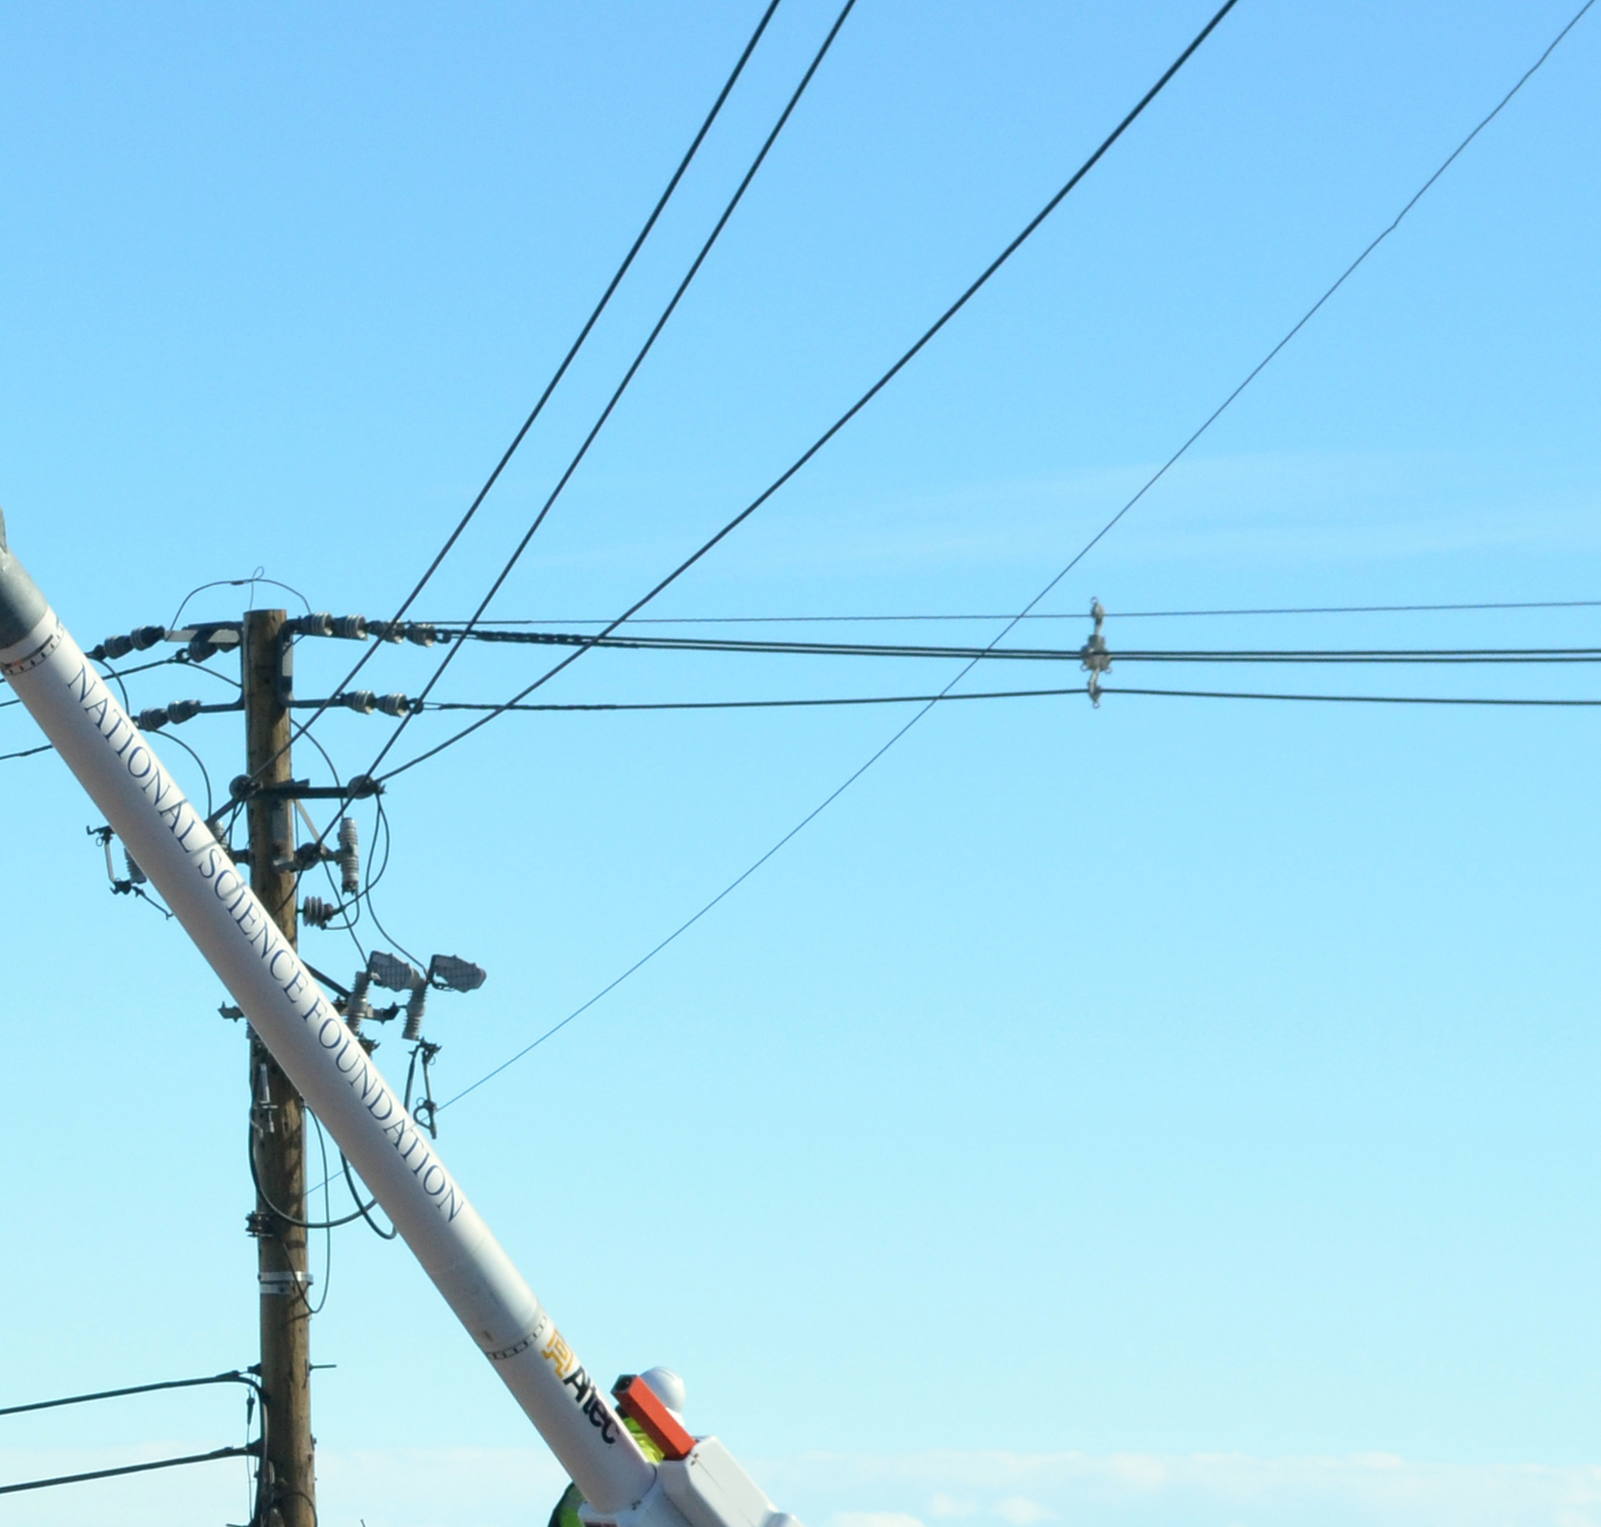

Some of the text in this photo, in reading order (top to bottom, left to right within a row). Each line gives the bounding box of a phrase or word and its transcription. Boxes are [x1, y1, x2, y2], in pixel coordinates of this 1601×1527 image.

[67, 664, 465, 1223] NATIONAL SCIENCE FOUNDATION
